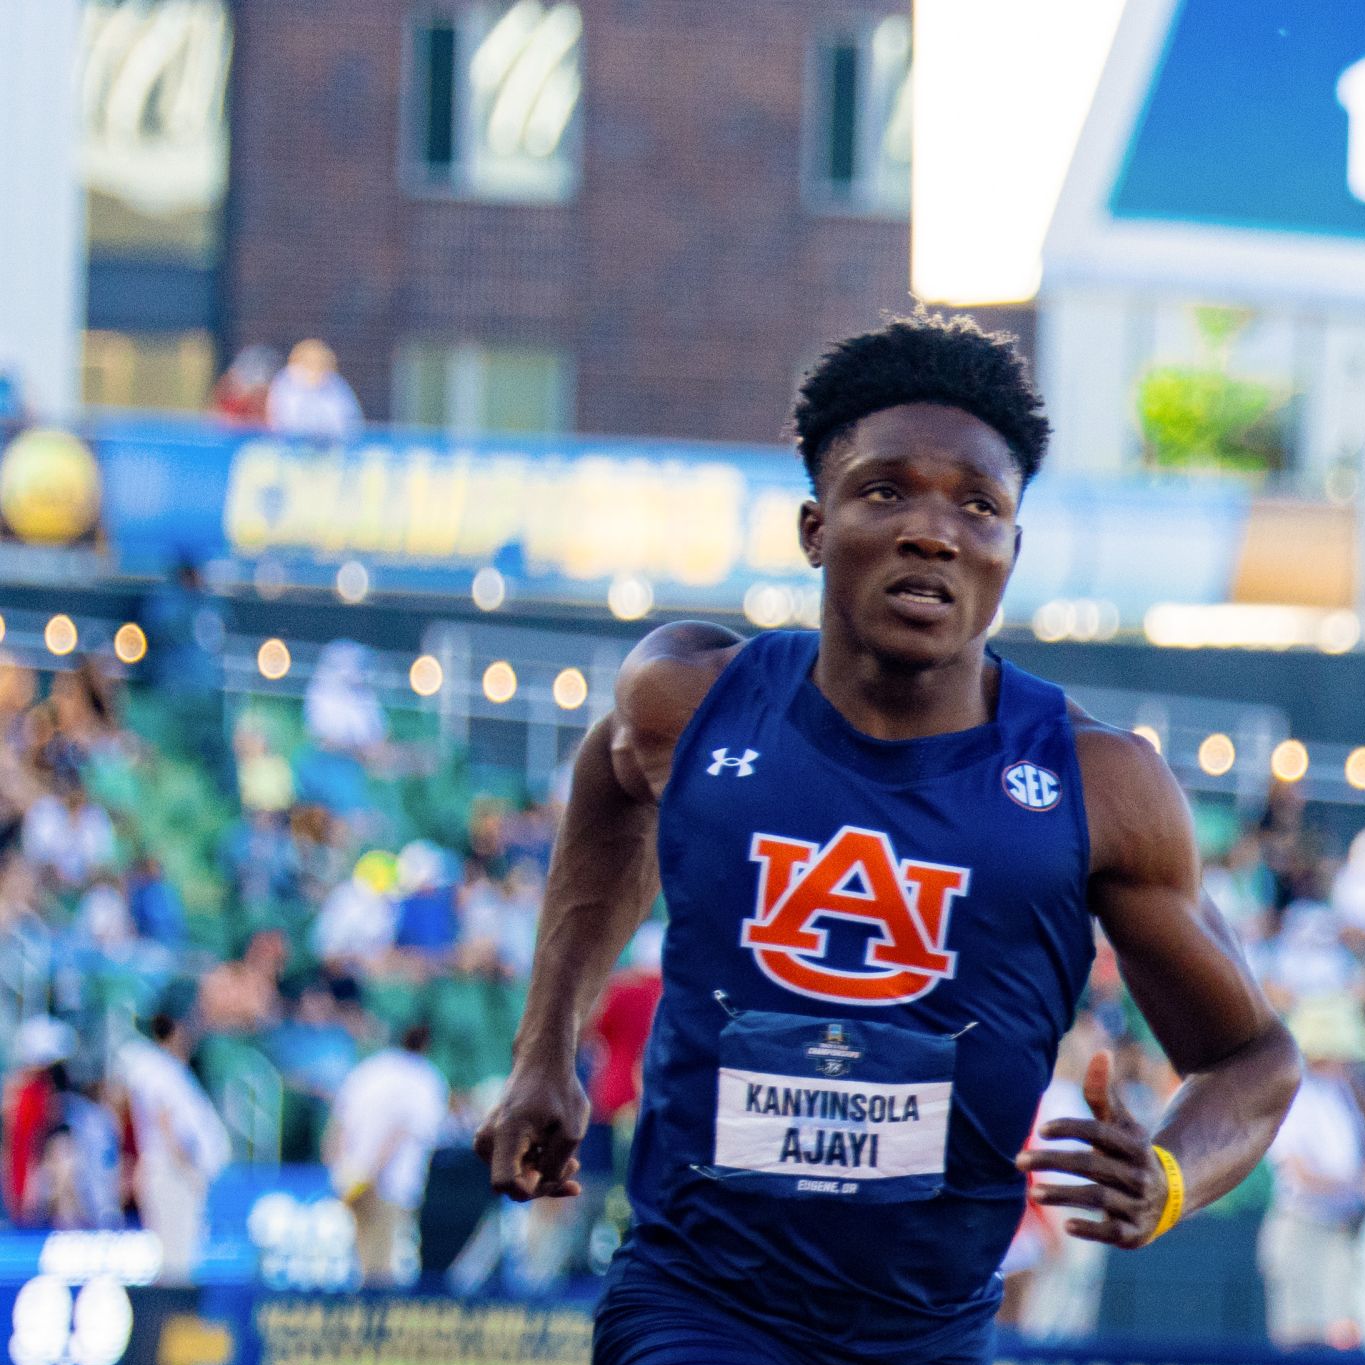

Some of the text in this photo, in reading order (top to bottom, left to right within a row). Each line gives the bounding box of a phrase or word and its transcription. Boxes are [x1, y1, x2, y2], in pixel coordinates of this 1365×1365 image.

[1006, 764, 1058, 807] SEC
[745, 1083, 920, 1124] KANYINSOLA
[779, 1127, 880, 1168] AJAYI
[841, 1183, 859, 1194] OR
